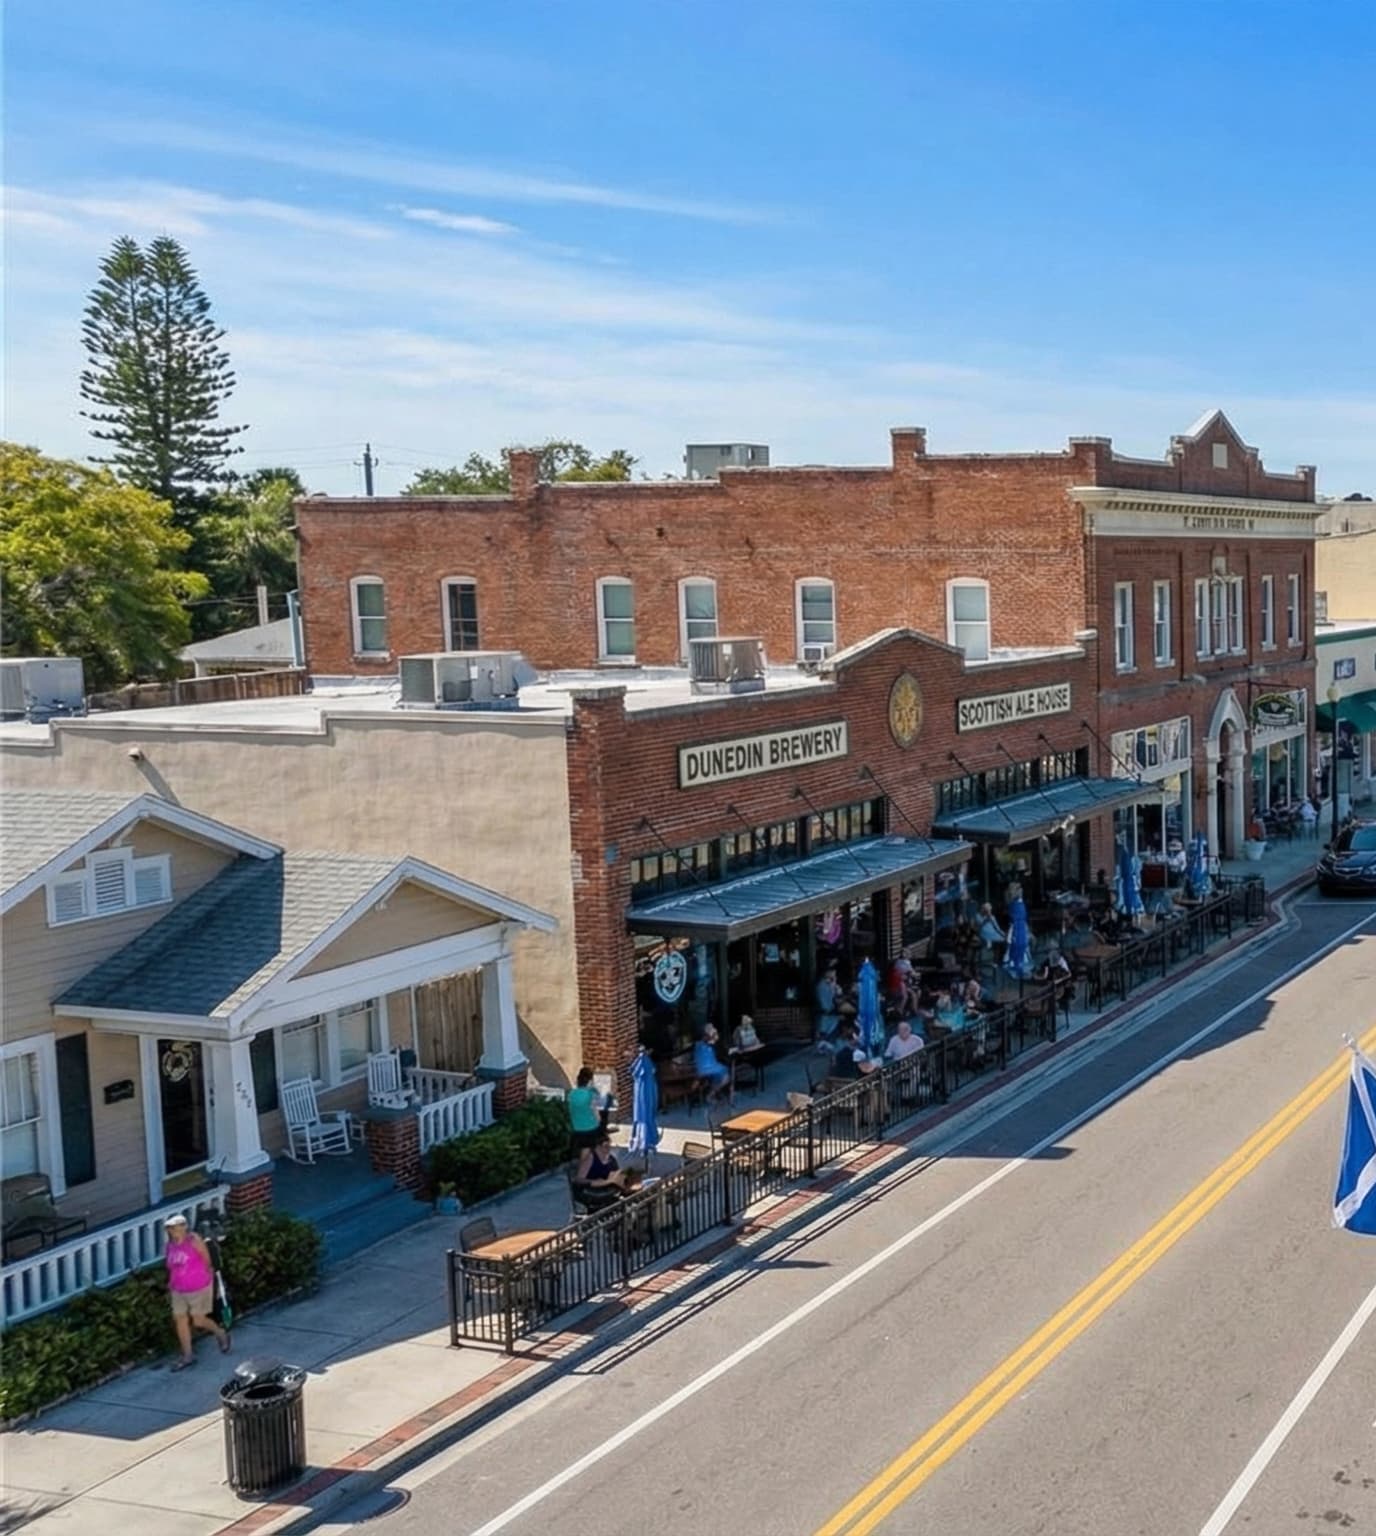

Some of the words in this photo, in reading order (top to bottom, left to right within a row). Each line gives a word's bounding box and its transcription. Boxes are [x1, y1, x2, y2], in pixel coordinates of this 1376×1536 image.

[960, 695, 1013, 727] SCOTTISH
[1015, 693, 1035, 717] ALE
[1037, 687, 1069, 711] HOUSE
[687, 742, 764, 781] DUNEDIN
[769, 727, 843, 764] BREWERY
